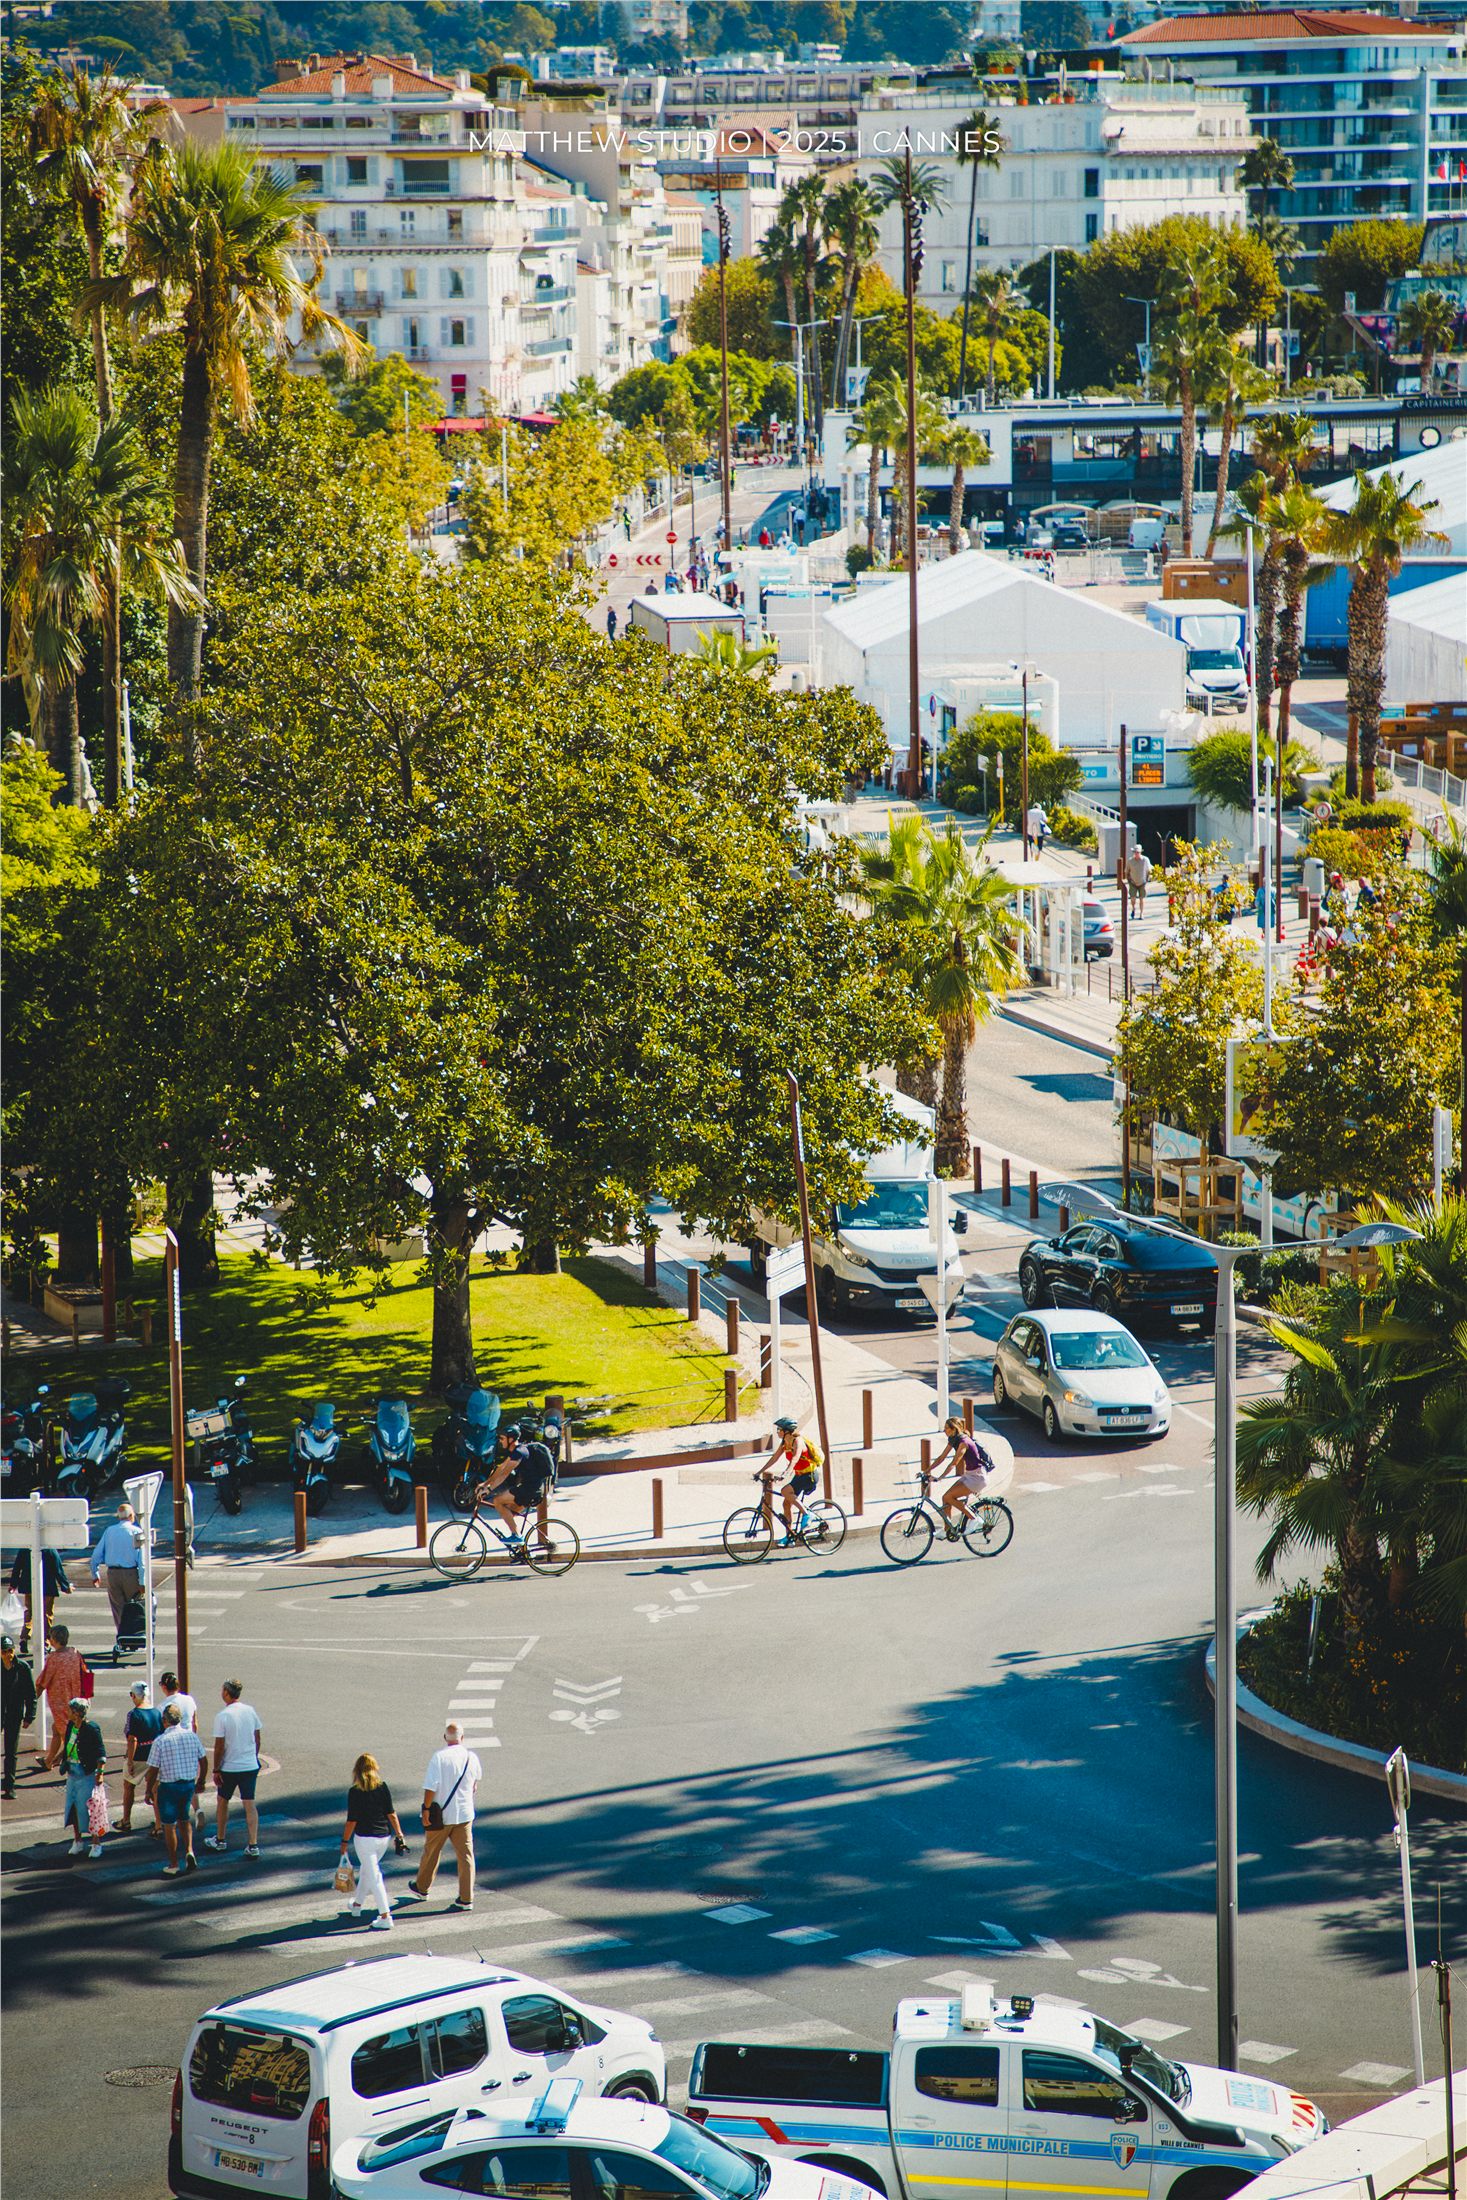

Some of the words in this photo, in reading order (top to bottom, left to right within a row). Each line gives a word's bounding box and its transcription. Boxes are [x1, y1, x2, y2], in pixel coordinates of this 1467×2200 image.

[1138, 737, 1148, 751] P
[599, 2058, 604, 2068] 8
[211, 2117, 269, 2134] PEUGEOT
[249, 2134, 255, 2144] 8
[935, 2134, 982, 2149] POLICE
[987, 2138, 1068, 2155] MUNICIPALE
[1183, 2141, 1205, 2150] CANNES
